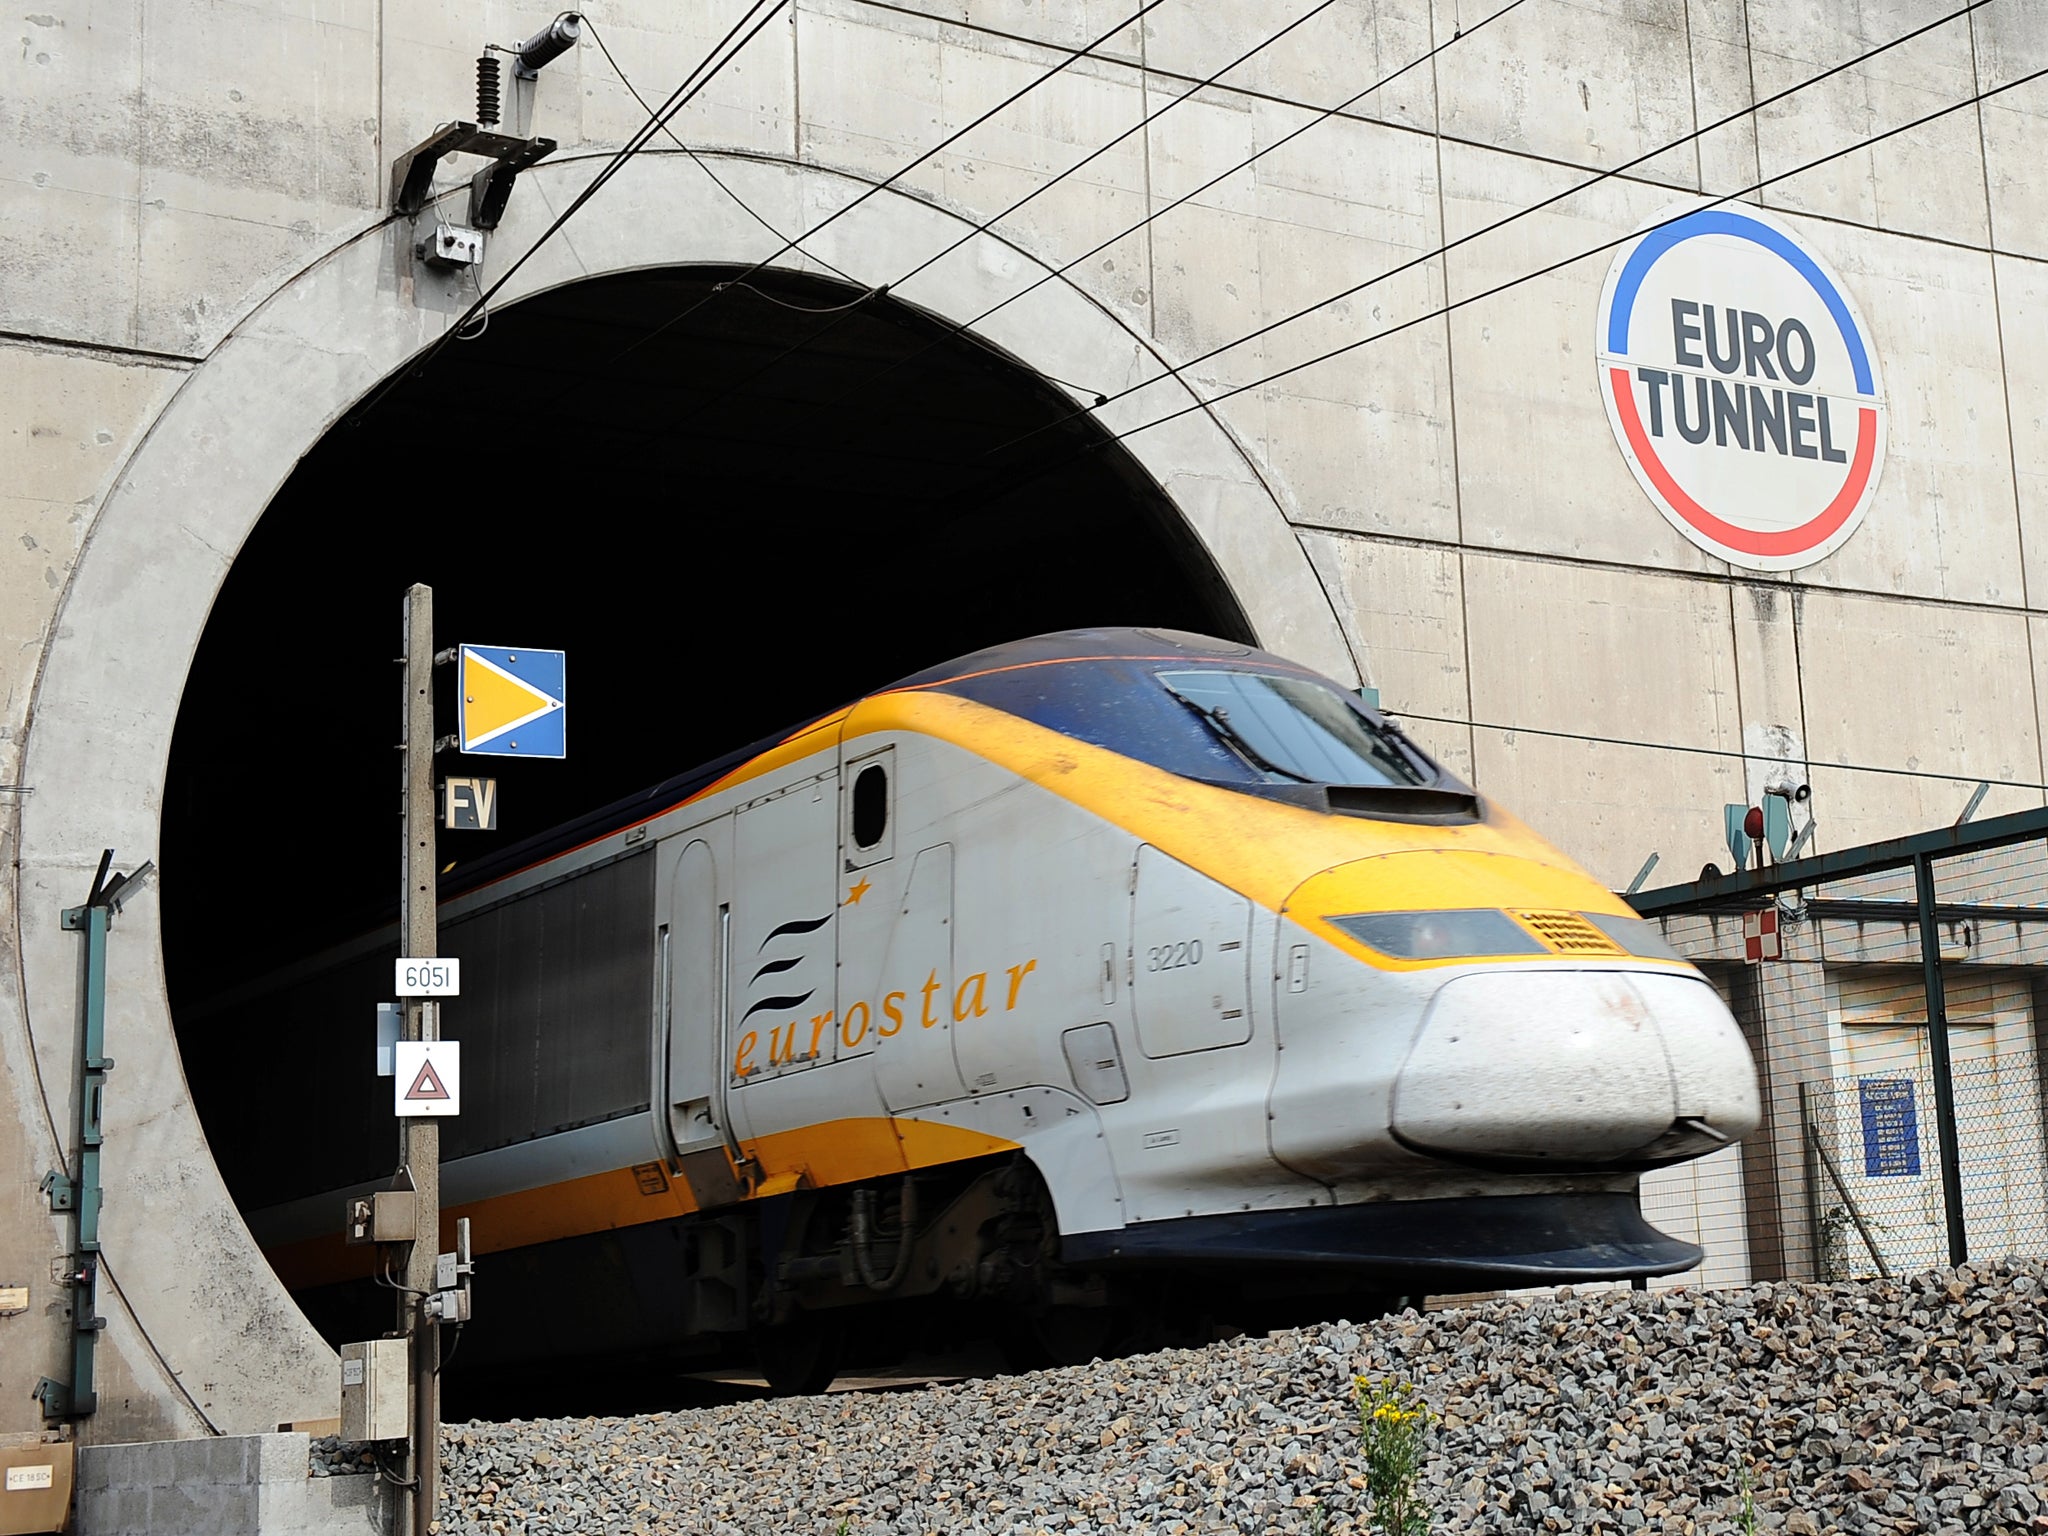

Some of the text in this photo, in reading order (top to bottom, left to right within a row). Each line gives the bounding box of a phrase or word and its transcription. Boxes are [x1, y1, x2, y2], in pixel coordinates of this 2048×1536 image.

[1670, 298, 1816, 386] EURO
[1638, 368, 1847, 464] TUNNEL
[447, 777, 496, 829] FV
[406, 966, 449, 987] 6051
[1147, 939, 1203, 972] 3220
[735, 959, 1037, 1077] eurostar
